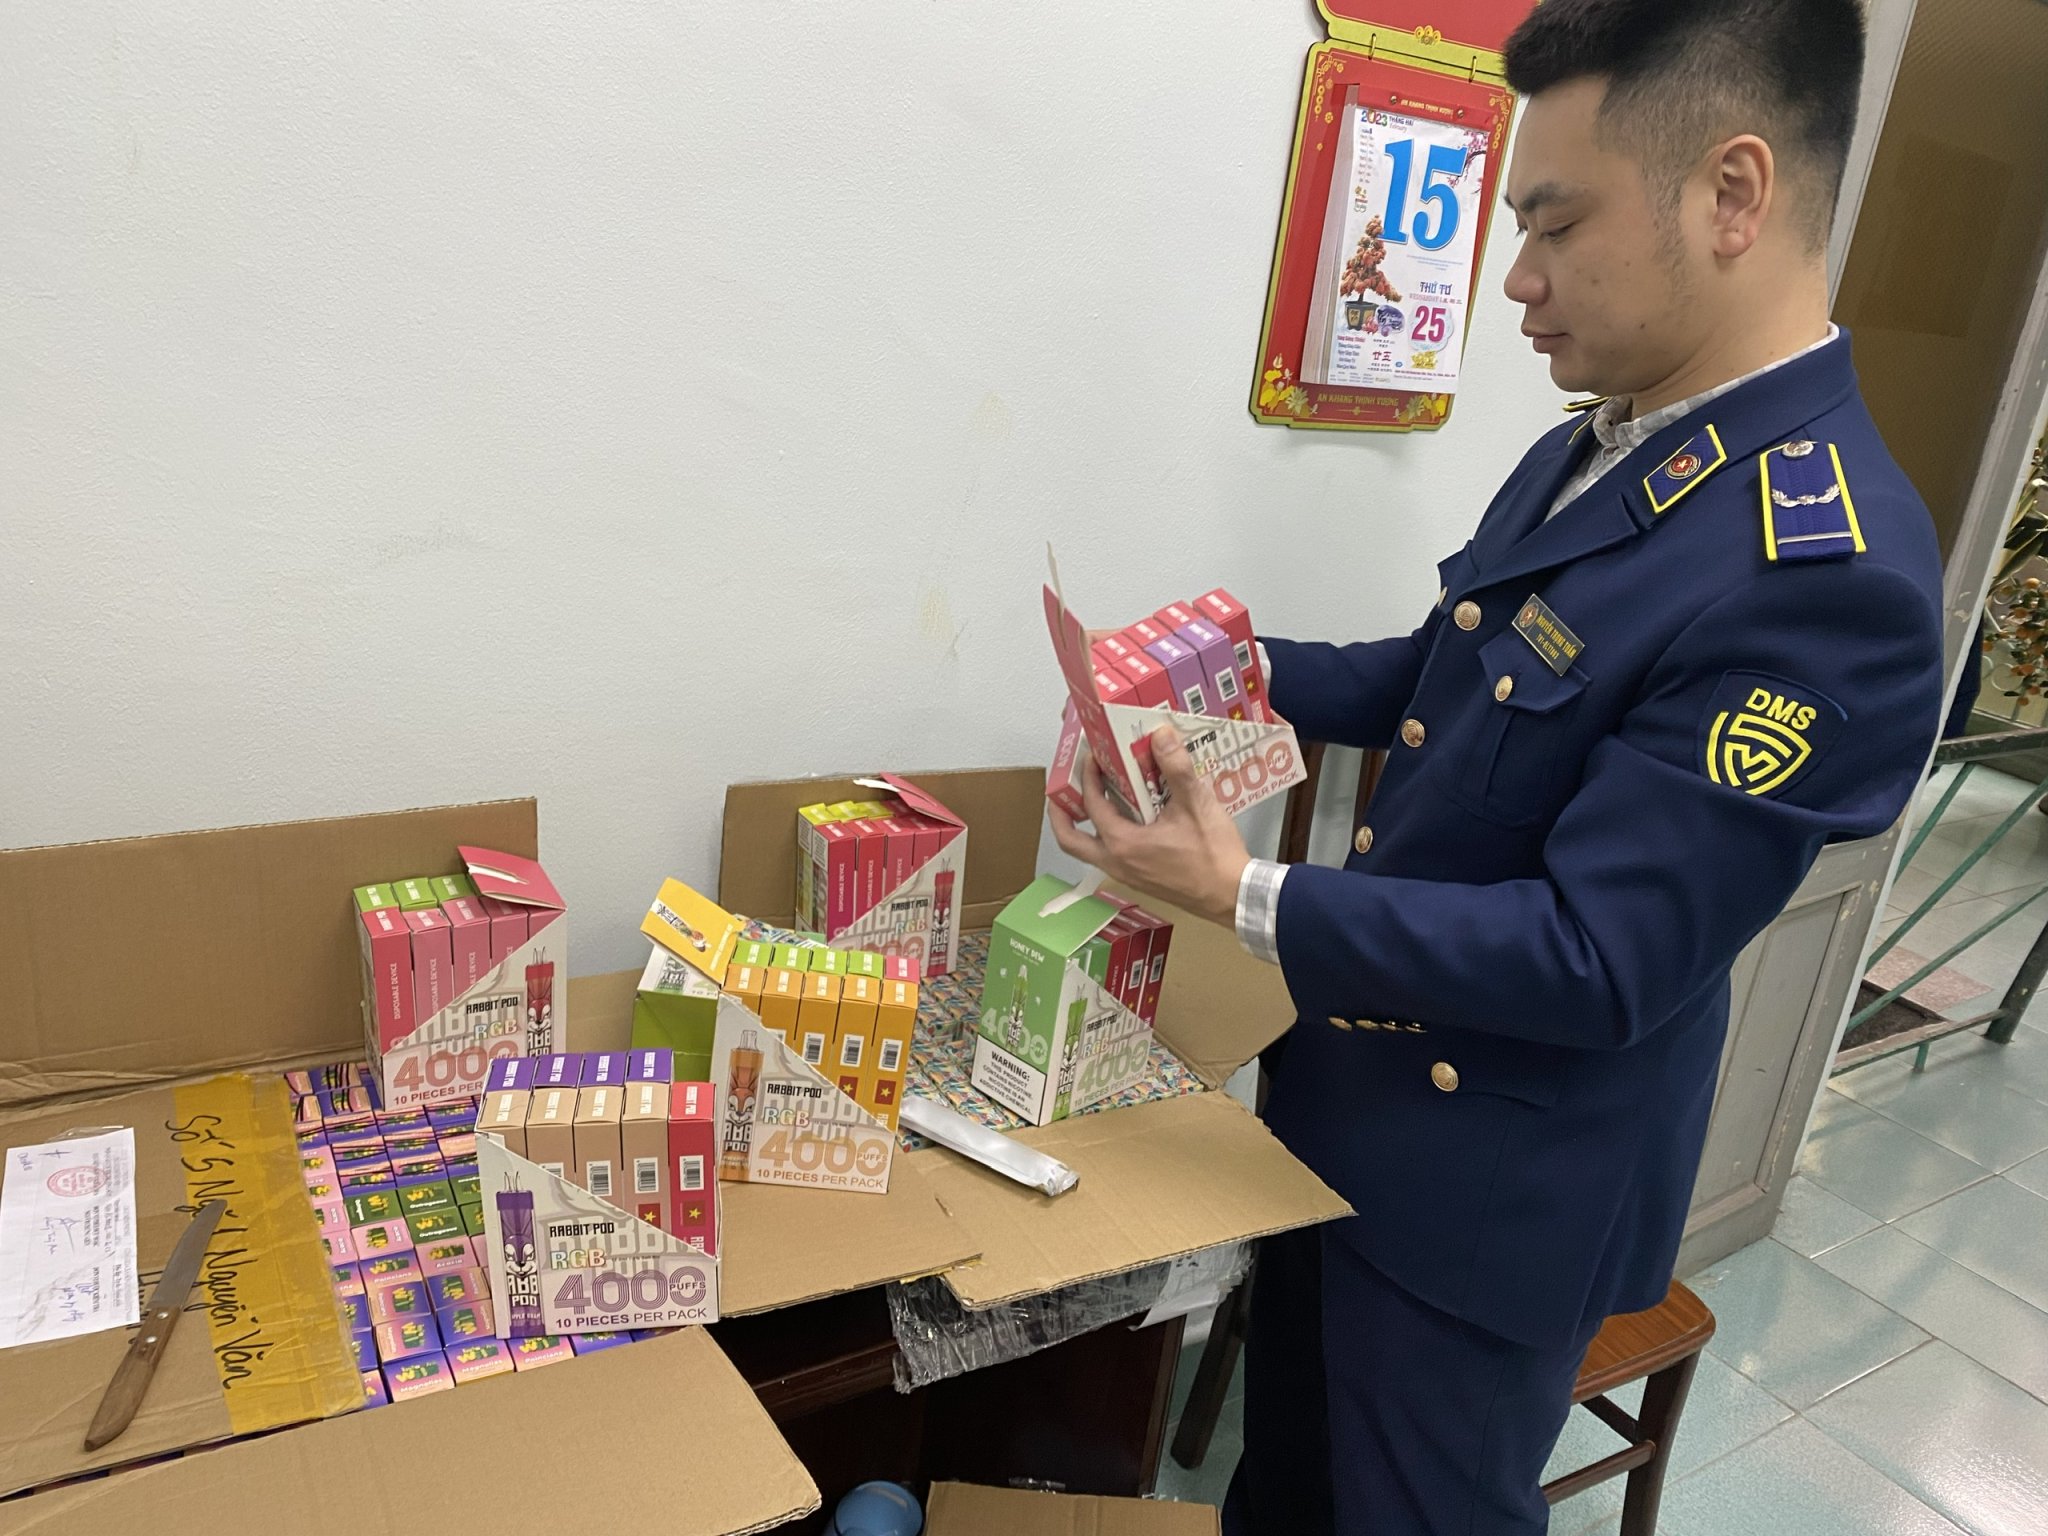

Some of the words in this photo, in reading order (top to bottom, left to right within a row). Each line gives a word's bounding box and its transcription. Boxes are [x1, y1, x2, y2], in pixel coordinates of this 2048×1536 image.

[1361, 109, 1388, 127] 2023
[1378, 139, 1468, 251] 15
[1411, 305, 1447, 343] 25
[1745, 687, 1817, 730] DMS
[1200, 731, 1218, 746] POD
[1193, 755, 1219, 778] GB
[1213, 740, 1294, 804] 000
[1225, 800, 1247, 815] CES
[1248, 787, 1269, 803] PER
[1271, 770, 1298, 792] PACK
[895, 919, 927, 934] RGB
[429, 958, 438, 980] DEVICE
[468, 952, 477, 973] DEVICE
[389, 963, 398, 984] DEVICE
[392, 984, 402, 1020] DISPOSABLE
[466, 1000, 499, 1014] RABBIT
[501, 996, 519, 1008] POD
[474, 1018, 518, 1040] RGB
[1084, 1037, 1110, 1058] RGB
[991, 1050, 1030, 1082] WARNING:
[394, 1095, 407, 1105] 10
[411, 1086, 456, 1102] PIECES
[458, 1082, 483, 1094] PER
[767, 1083, 801, 1096] RABBIT
[804, 1087, 822, 1098] POD
[763, 1107, 810, 1128] RGB
[759, 1130, 888, 1177] 4000
[857, 1152, 888, 1163] PUFFS
[756, 1169, 770, 1178] 10
[773, 1170, 818, 1183] PIECES
[821, 1175, 847, 1186] PER
[850, 1177, 885, 1189] PACK
[549, 1223, 590, 1238] RABBIT
[593, 1222, 615, 1234] POD
[551, 1249, 606, 1270] RGB
[554, 1266, 707, 1315] 4000
[669, 1281, 706, 1291] PUFFS
[512, 1295, 537, 1307] POD
[556, 1319, 571, 1329] 10
[576, 1314, 630, 1327] PIECES
[633, 1312, 664, 1323] PER
[667, 1308, 708, 1321] PACK
